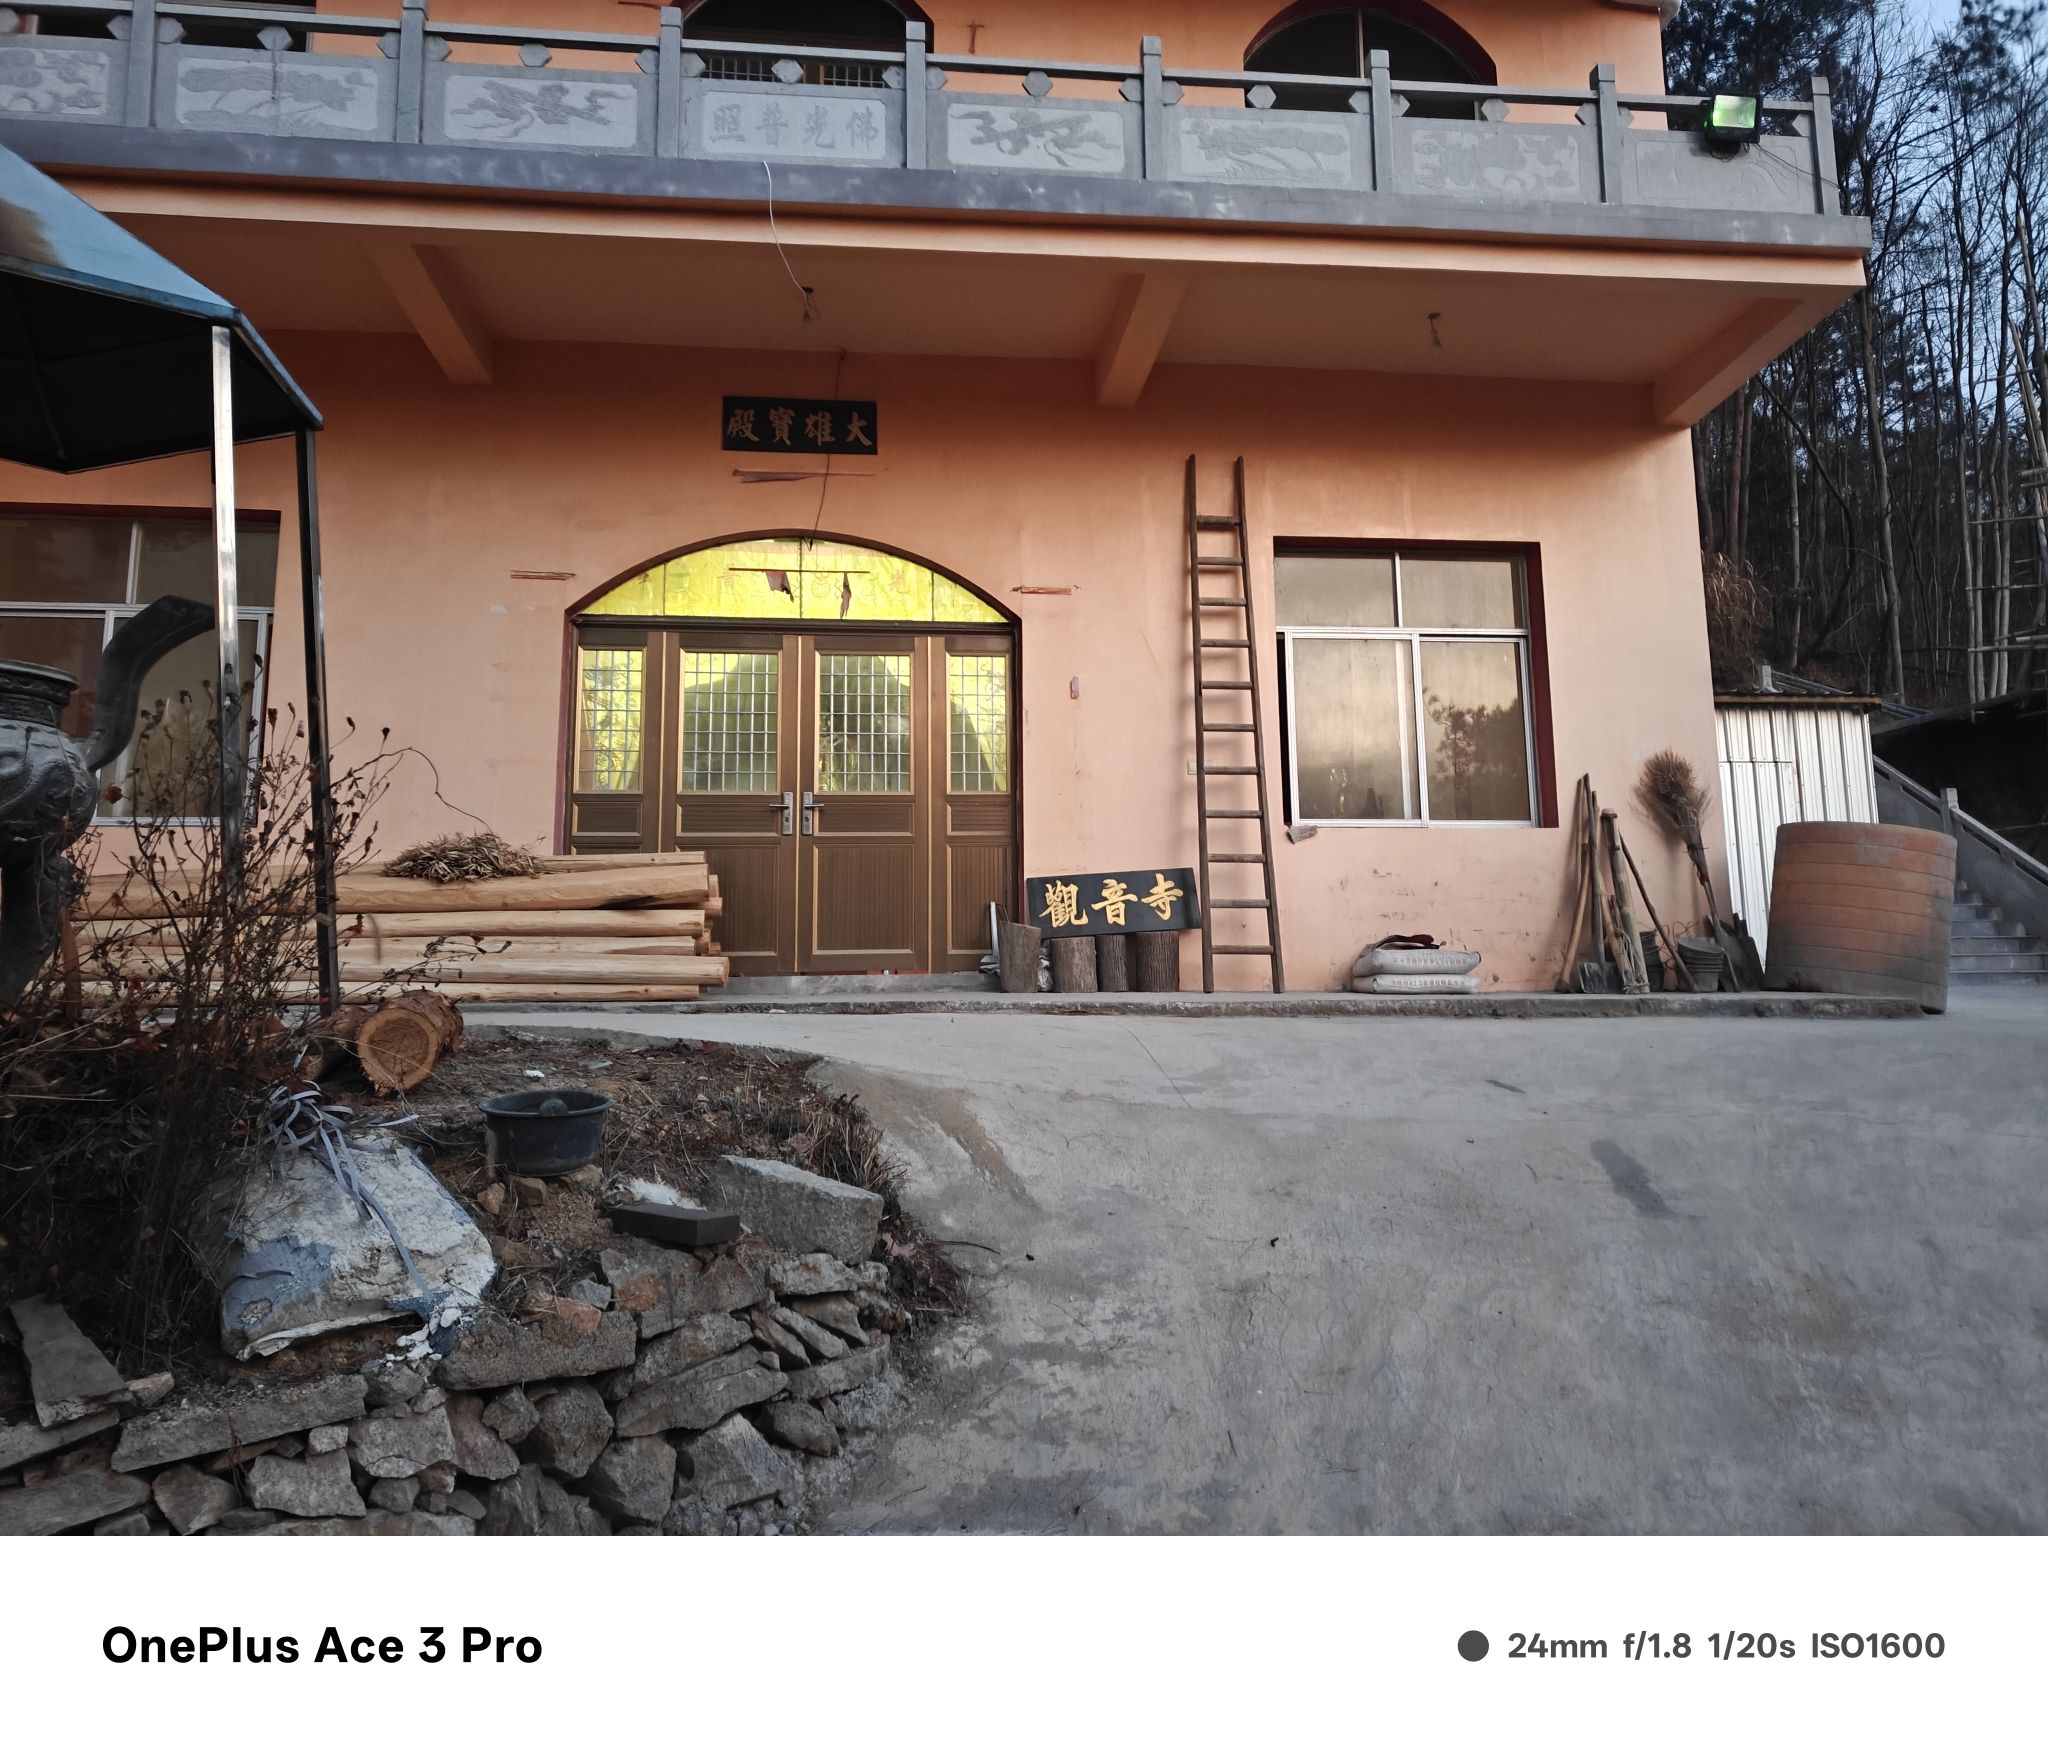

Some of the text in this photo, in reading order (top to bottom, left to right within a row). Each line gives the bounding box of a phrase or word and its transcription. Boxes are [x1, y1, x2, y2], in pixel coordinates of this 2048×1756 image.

[726, 406, 872, 447] 大雄寶殿
[1038, 873, 1184, 928] 觀音寺
